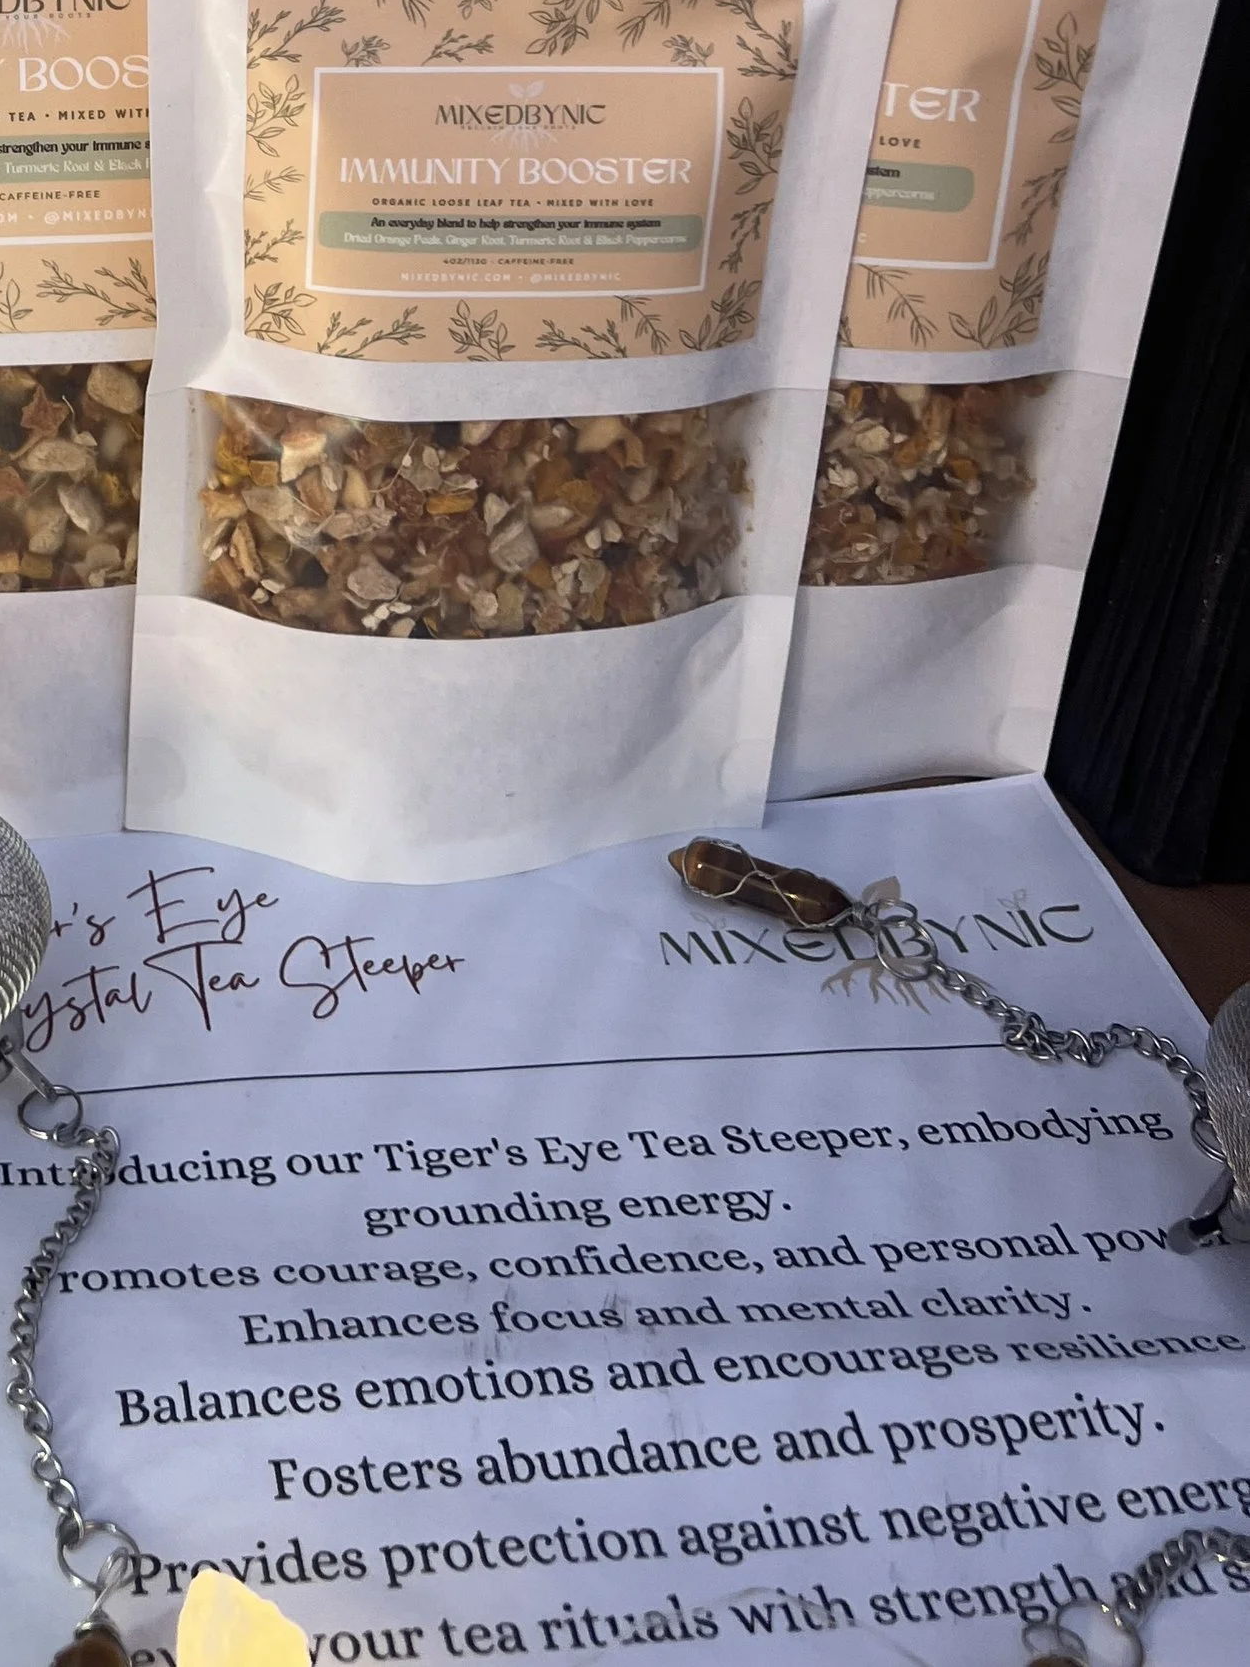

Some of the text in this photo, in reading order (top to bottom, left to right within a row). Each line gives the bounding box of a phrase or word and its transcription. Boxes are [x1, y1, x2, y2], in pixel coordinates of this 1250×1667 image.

[9, 112, 36, 122] TEA
[58, 110, 106, 121] MIXED
[434, 104, 606, 126] MIXEDBYNIC
[4, 162, 60, 175] Turmeric
[94, 160, 104, 172] &
[60, 142, 89, 156] your
[880, 136, 922, 149] LOVE
[340, 157, 692, 186] IMMUNITY BOOSTER
[372, 198, 654, 207] ORGANIC LOOSE LEAF TEA MIXED WITH LOVE
[467, 218, 477, 228] to
[127, 866, 279, 944] Eye
[143, 940, 260, 1032] Tea
[280, 935, 465, 1020] Steeper
[286, 1148, 364, 1176] our
[374, 1137, 528, 1178] Tiger's
[534, 1136, 622, 1172] Eye
[628, 1130, 716, 1160] Tea
[721, 1122, 908, 1167] Steeper,
[917, 1107, 1174, 1148] embodying
[364, 1188, 792, 1236] grounding energy.
[274, 1255, 478, 1289] courage,
[489, 1243, 764, 1279] confidence,
[772, 1235, 866, 1270] and
[870, 1222, 1079, 1273] personal
[239, 1285, 1092, 1345] Enhances focus and mental clarity.
[116, 1333, 1247, 1427] Balances emotions and encourages resilience
[267, 1392, 1165, 1501] Fosters abundance and prosperity.
[379, 1517, 668, 1589] protection
[680, 1504, 869, 1565] against
[882, 1482, 1107, 1546] negative
[438, 1618, 525, 1658] tea
[538, 1594, 719, 1651] rituals
[730, 1582, 855, 1636] with
